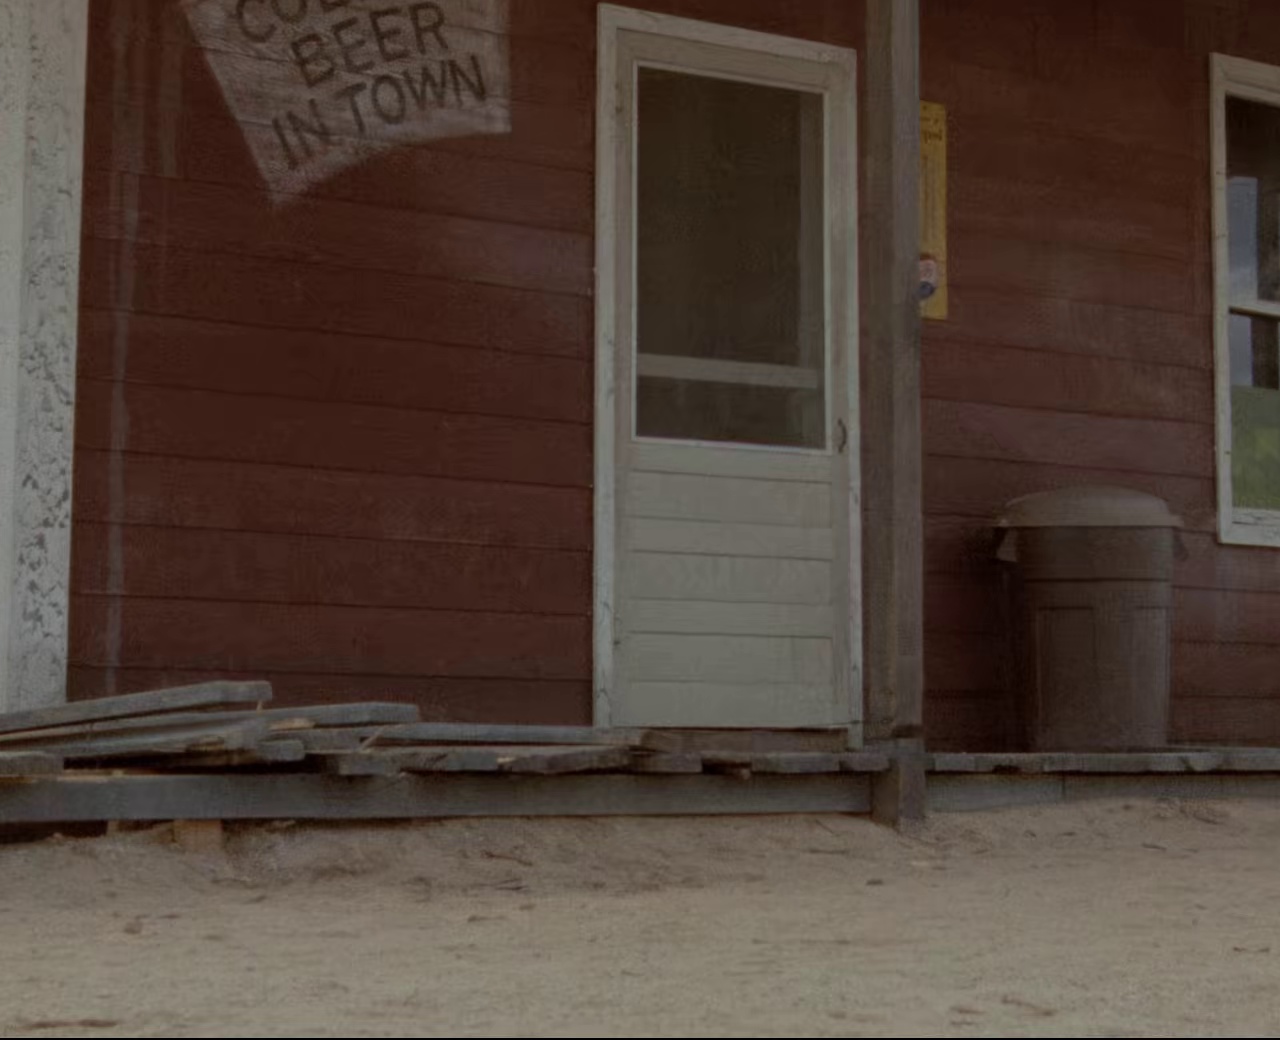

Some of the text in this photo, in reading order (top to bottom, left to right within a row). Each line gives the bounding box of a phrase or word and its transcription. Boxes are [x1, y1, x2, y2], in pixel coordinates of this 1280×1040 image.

[290, 0, 448, 89] BEER
[271, 54, 487, 169] IN TOWN
